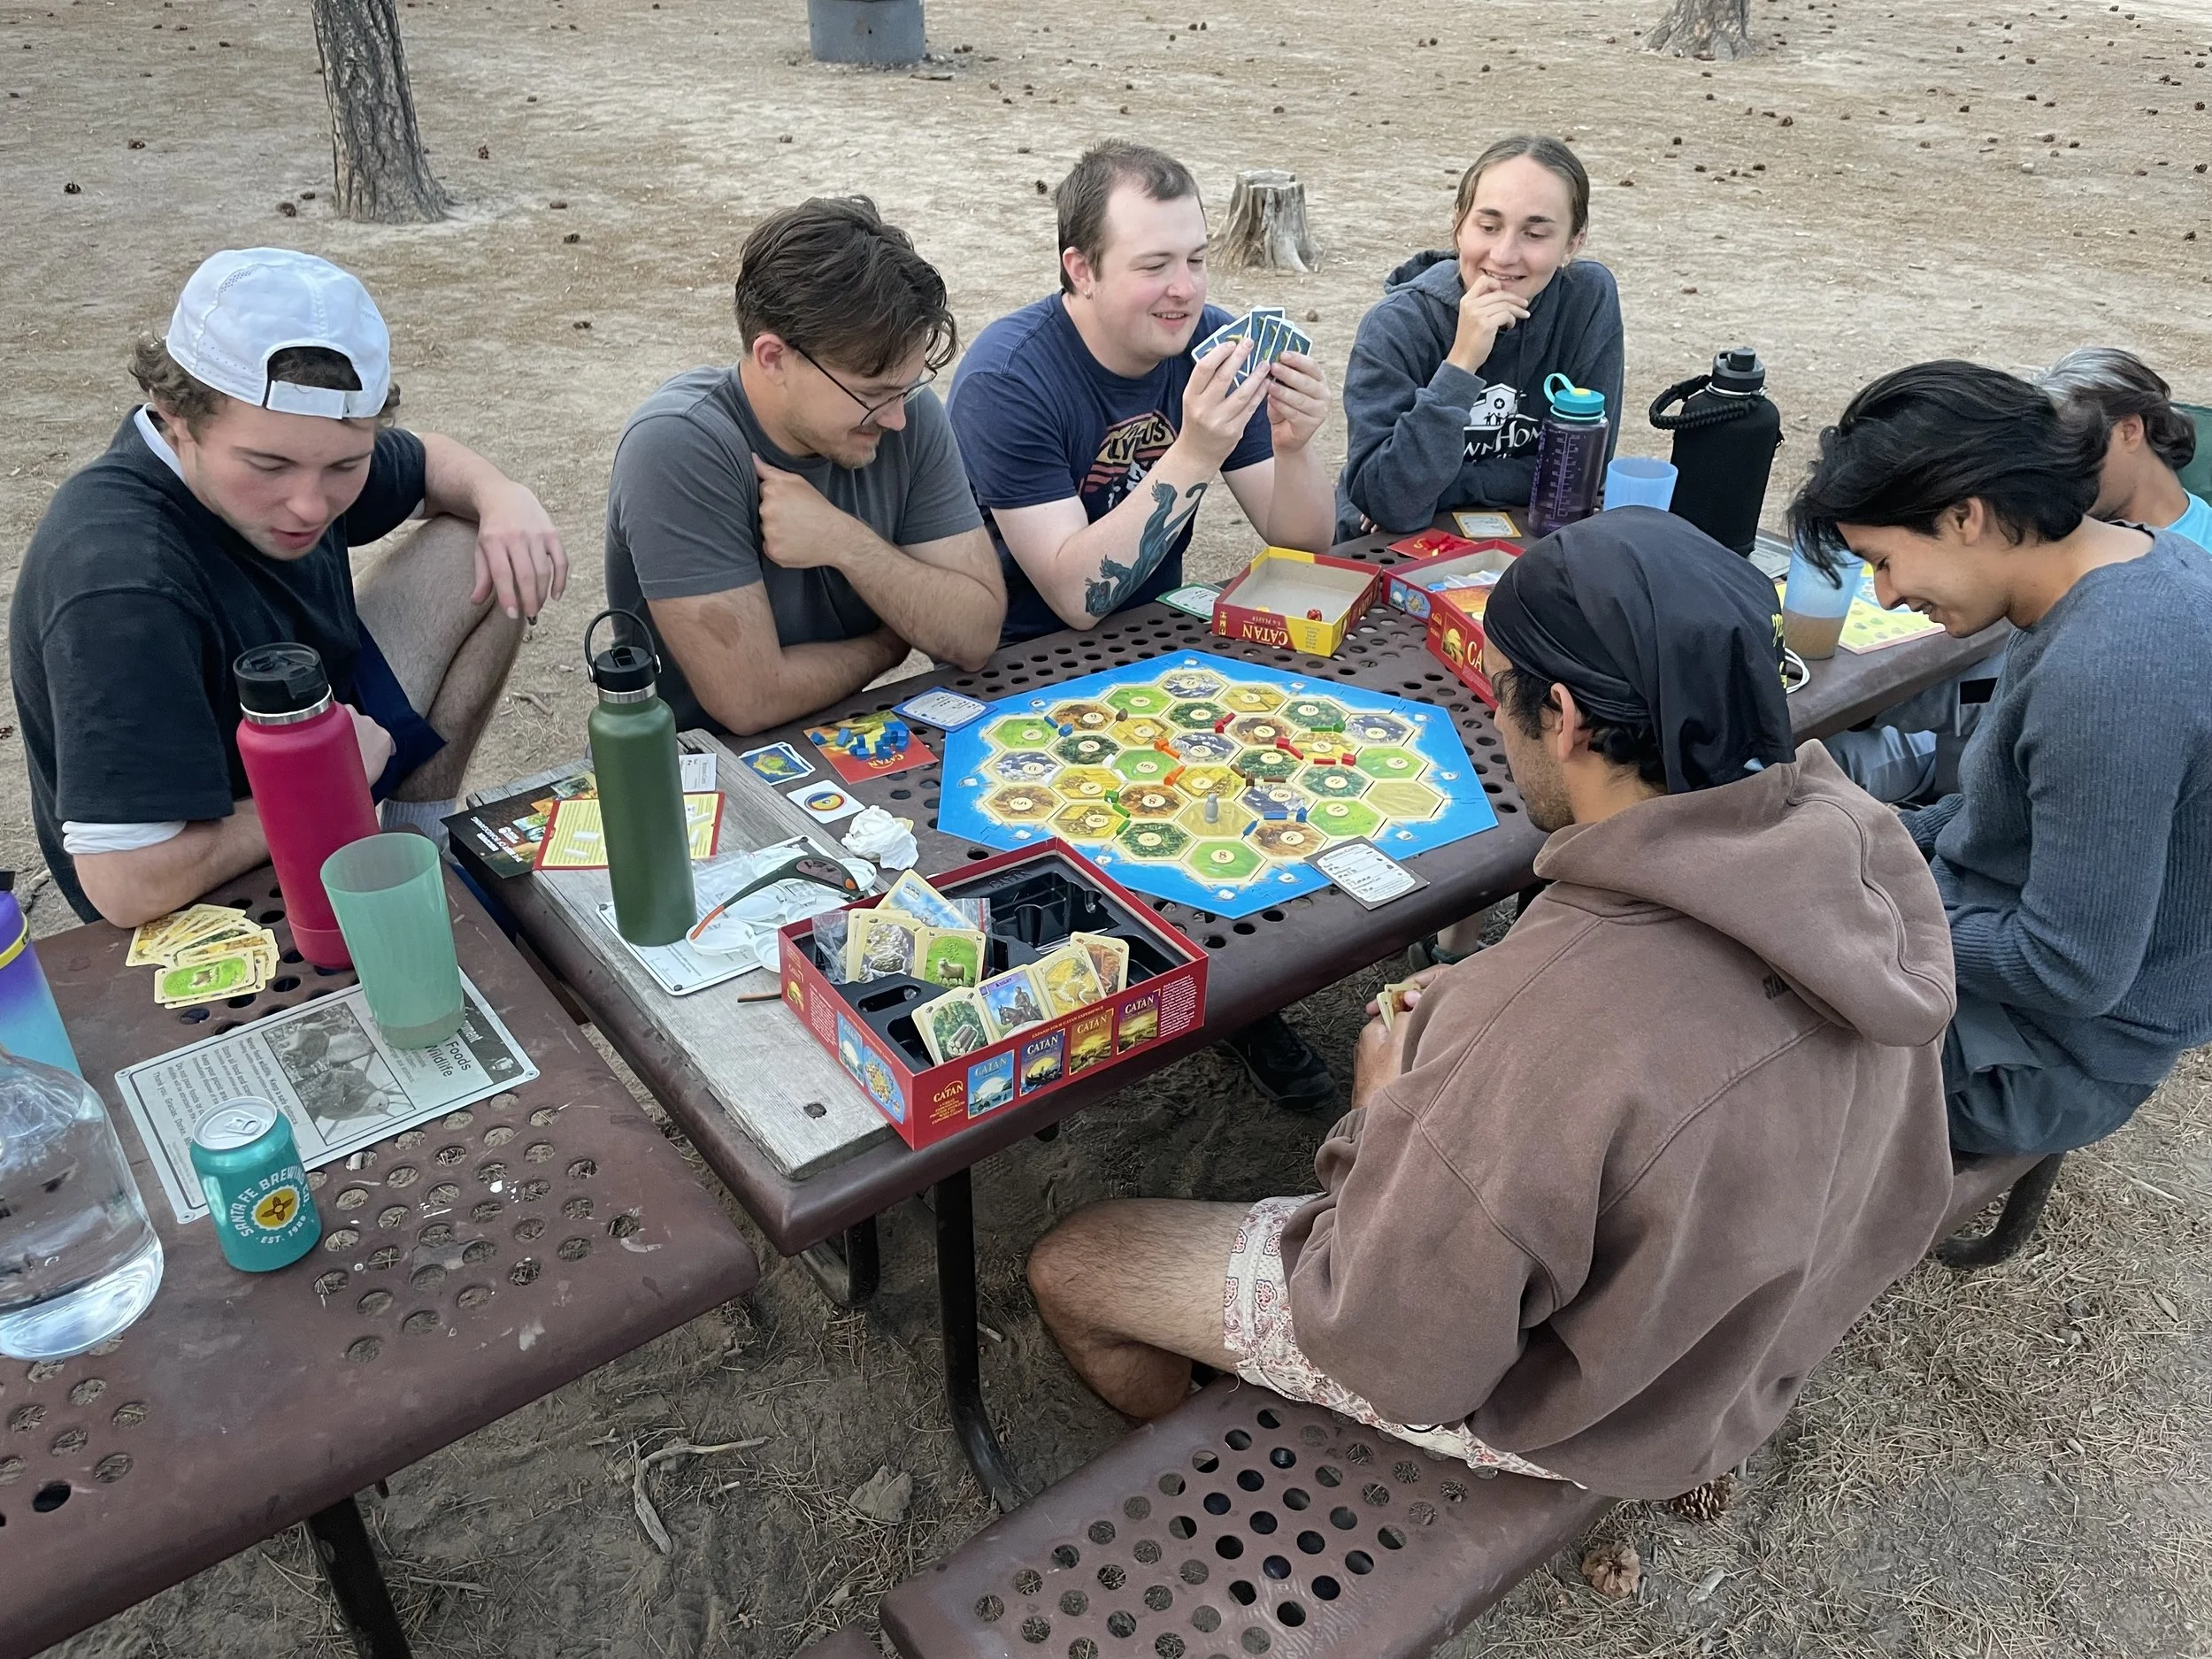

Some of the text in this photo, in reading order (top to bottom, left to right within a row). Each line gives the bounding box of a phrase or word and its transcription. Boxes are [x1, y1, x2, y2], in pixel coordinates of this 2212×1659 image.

[1242, 624, 1288, 645] CATAN
[1125, 995, 1155, 1014] CATAN
[1077, 1014, 1107, 1033] CATAN
[1027, 1035, 1059, 1055] CATAN
[446, 1041, 472, 1071] Foods
[975, 1056, 1007, 1077] CATAN
[933, 1083, 964, 1102] CATAN
[259, 1165, 305, 1191] BREWING
[238, 1188, 258, 1202] FE
[230, 1202, 254, 1236] SANTA
[261, 1235, 285, 1244] EST.
